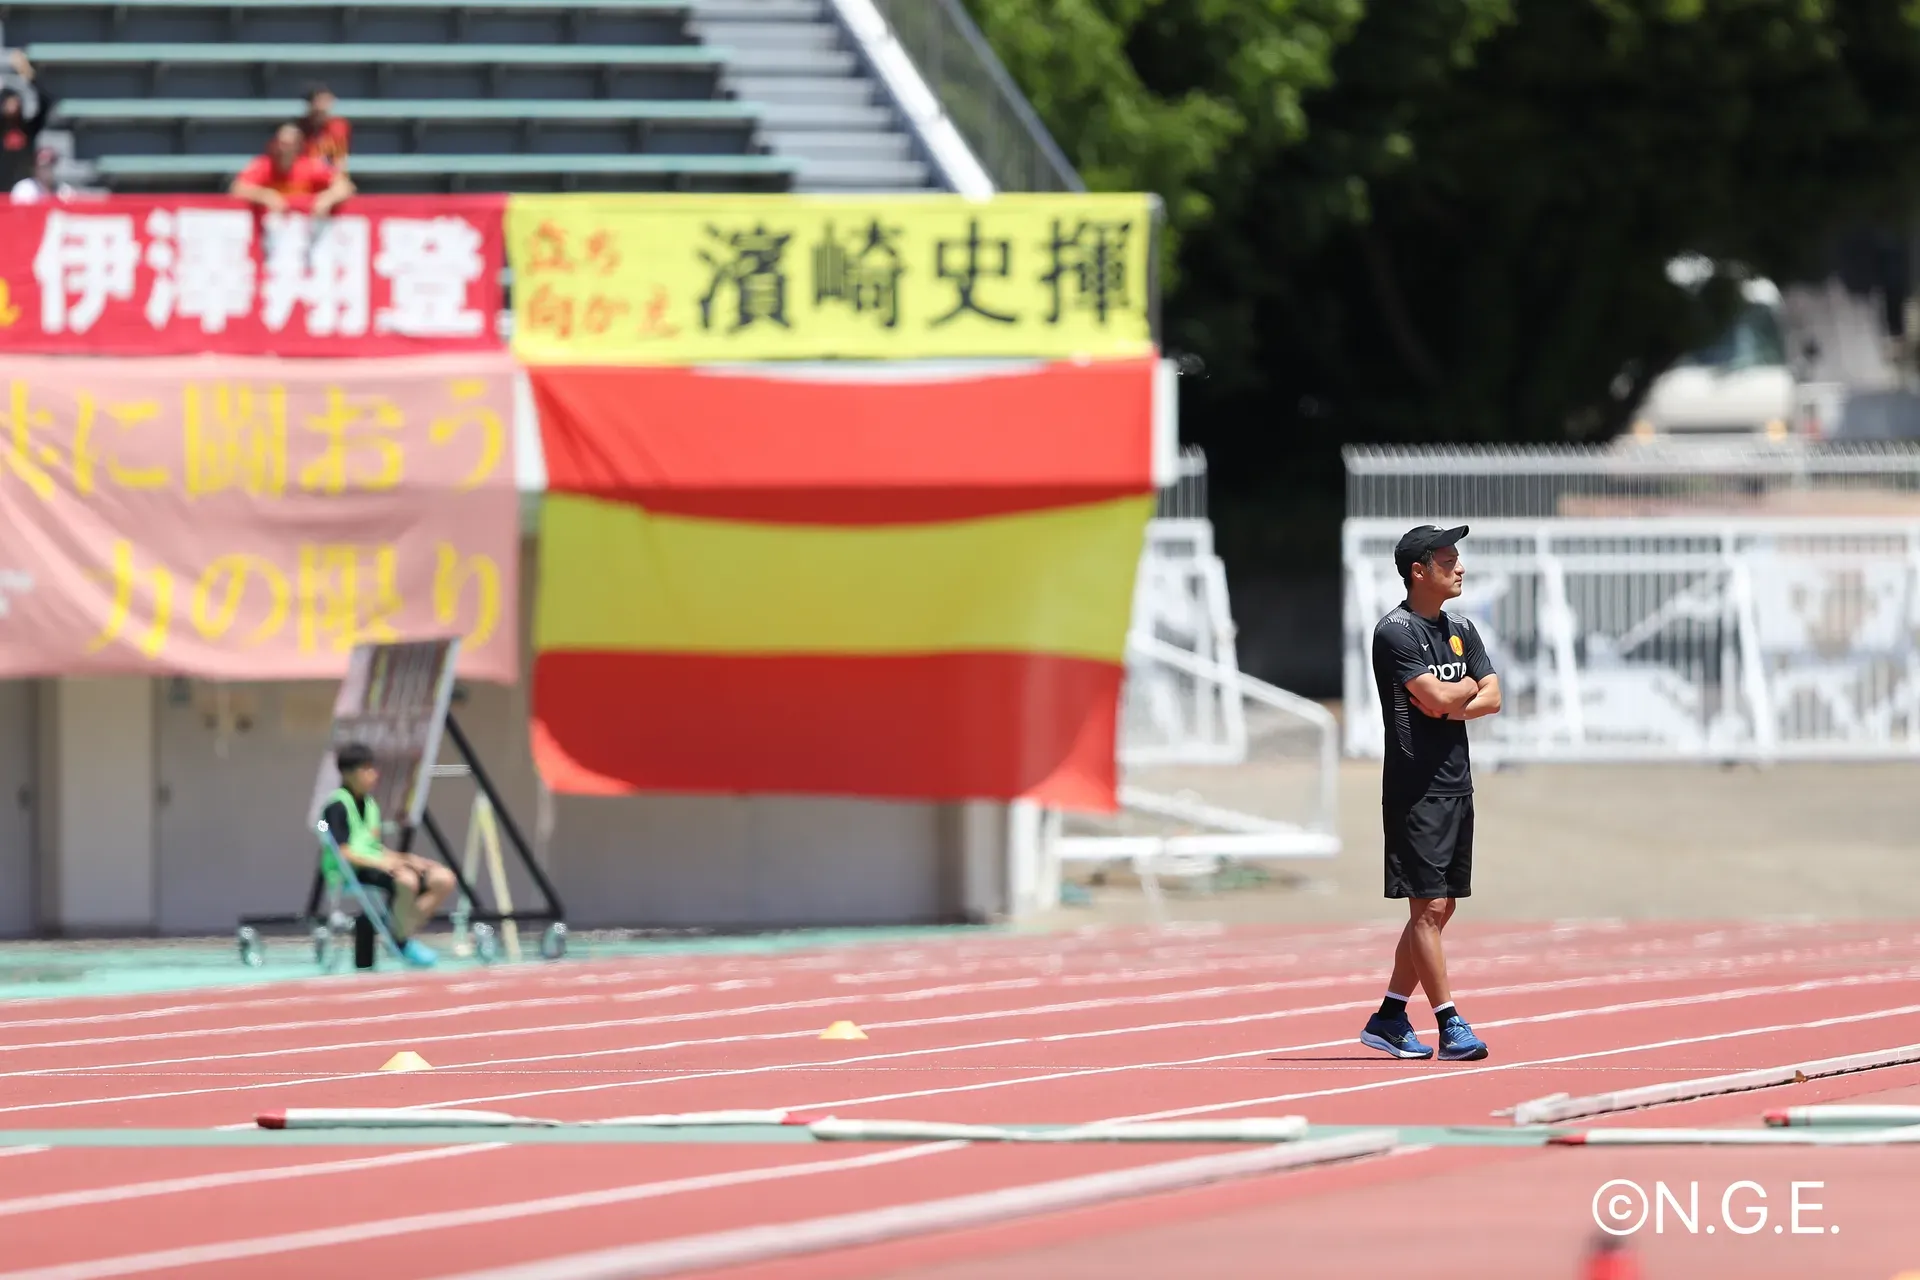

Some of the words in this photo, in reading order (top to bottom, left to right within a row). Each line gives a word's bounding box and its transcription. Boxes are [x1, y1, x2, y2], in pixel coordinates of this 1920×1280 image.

[33, 208, 485, 336] 伊澤翔登
[82, 540, 500, 657] 力の限り
